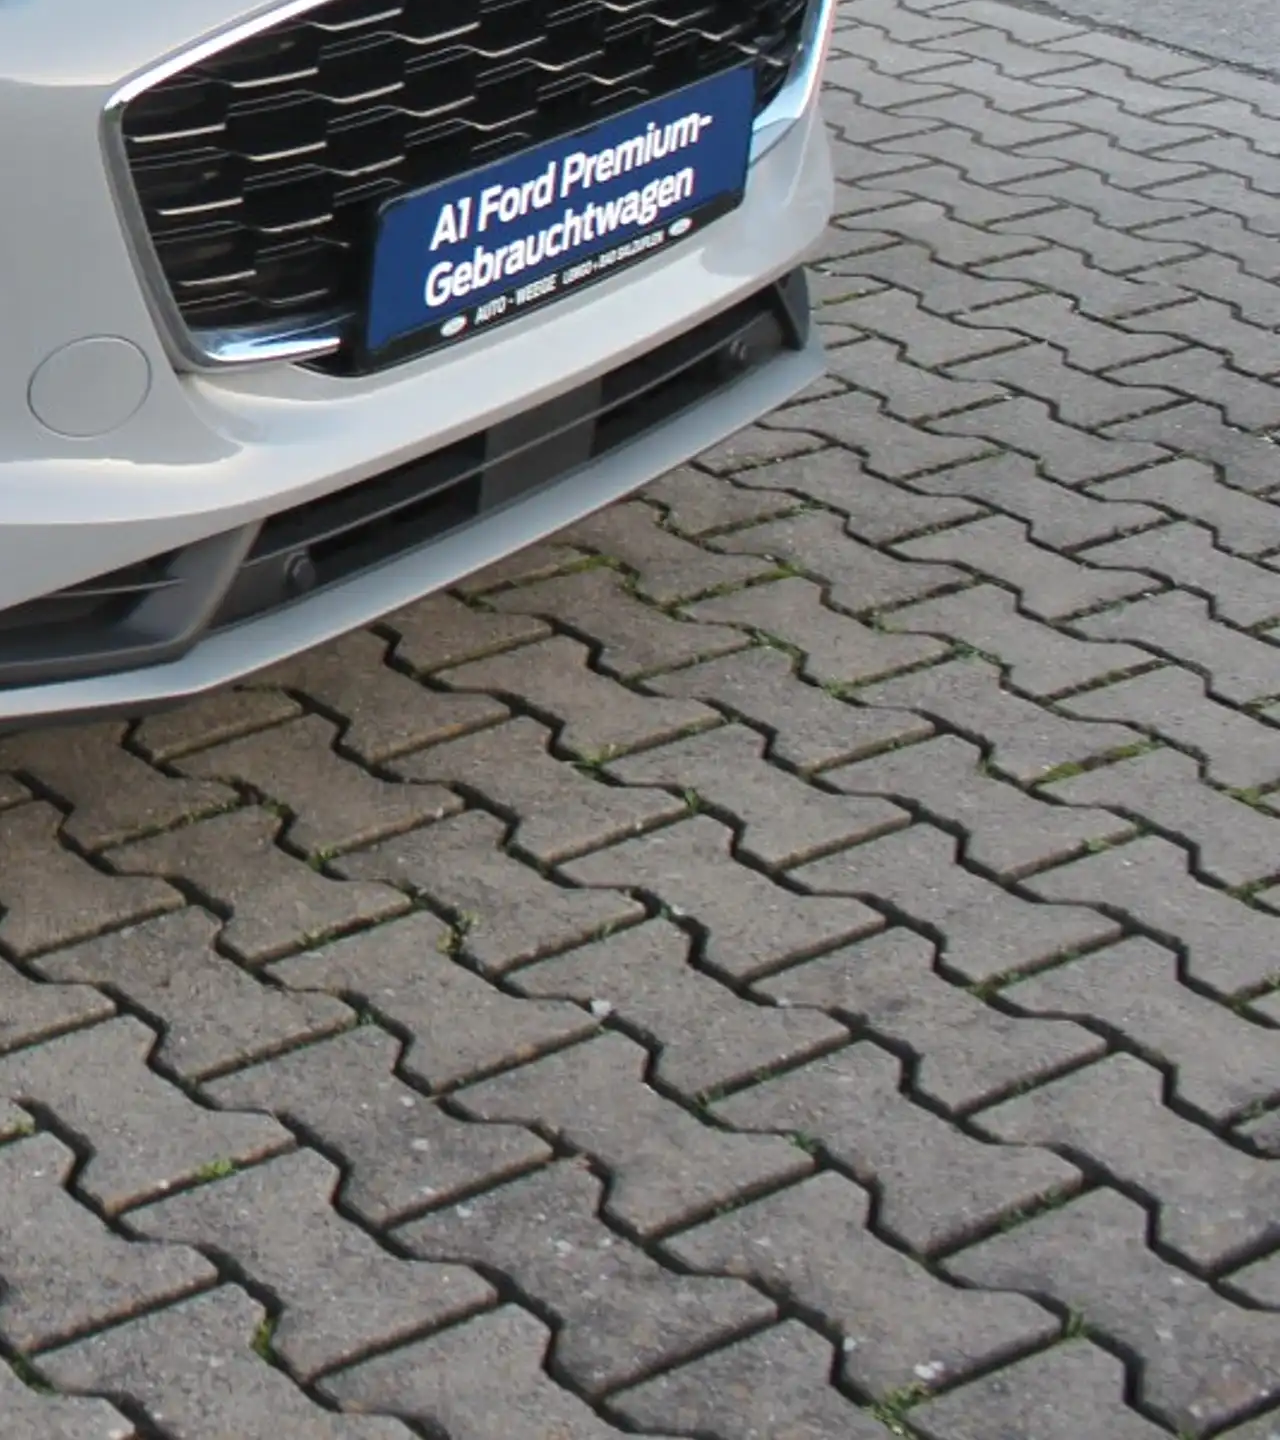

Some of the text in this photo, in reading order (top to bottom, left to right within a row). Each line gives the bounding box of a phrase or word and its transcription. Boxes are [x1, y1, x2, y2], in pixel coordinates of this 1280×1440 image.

[424, 166, 694, 308] Gebrauchtwagen
[429, 112, 713, 251] A1 Ford Premium-
